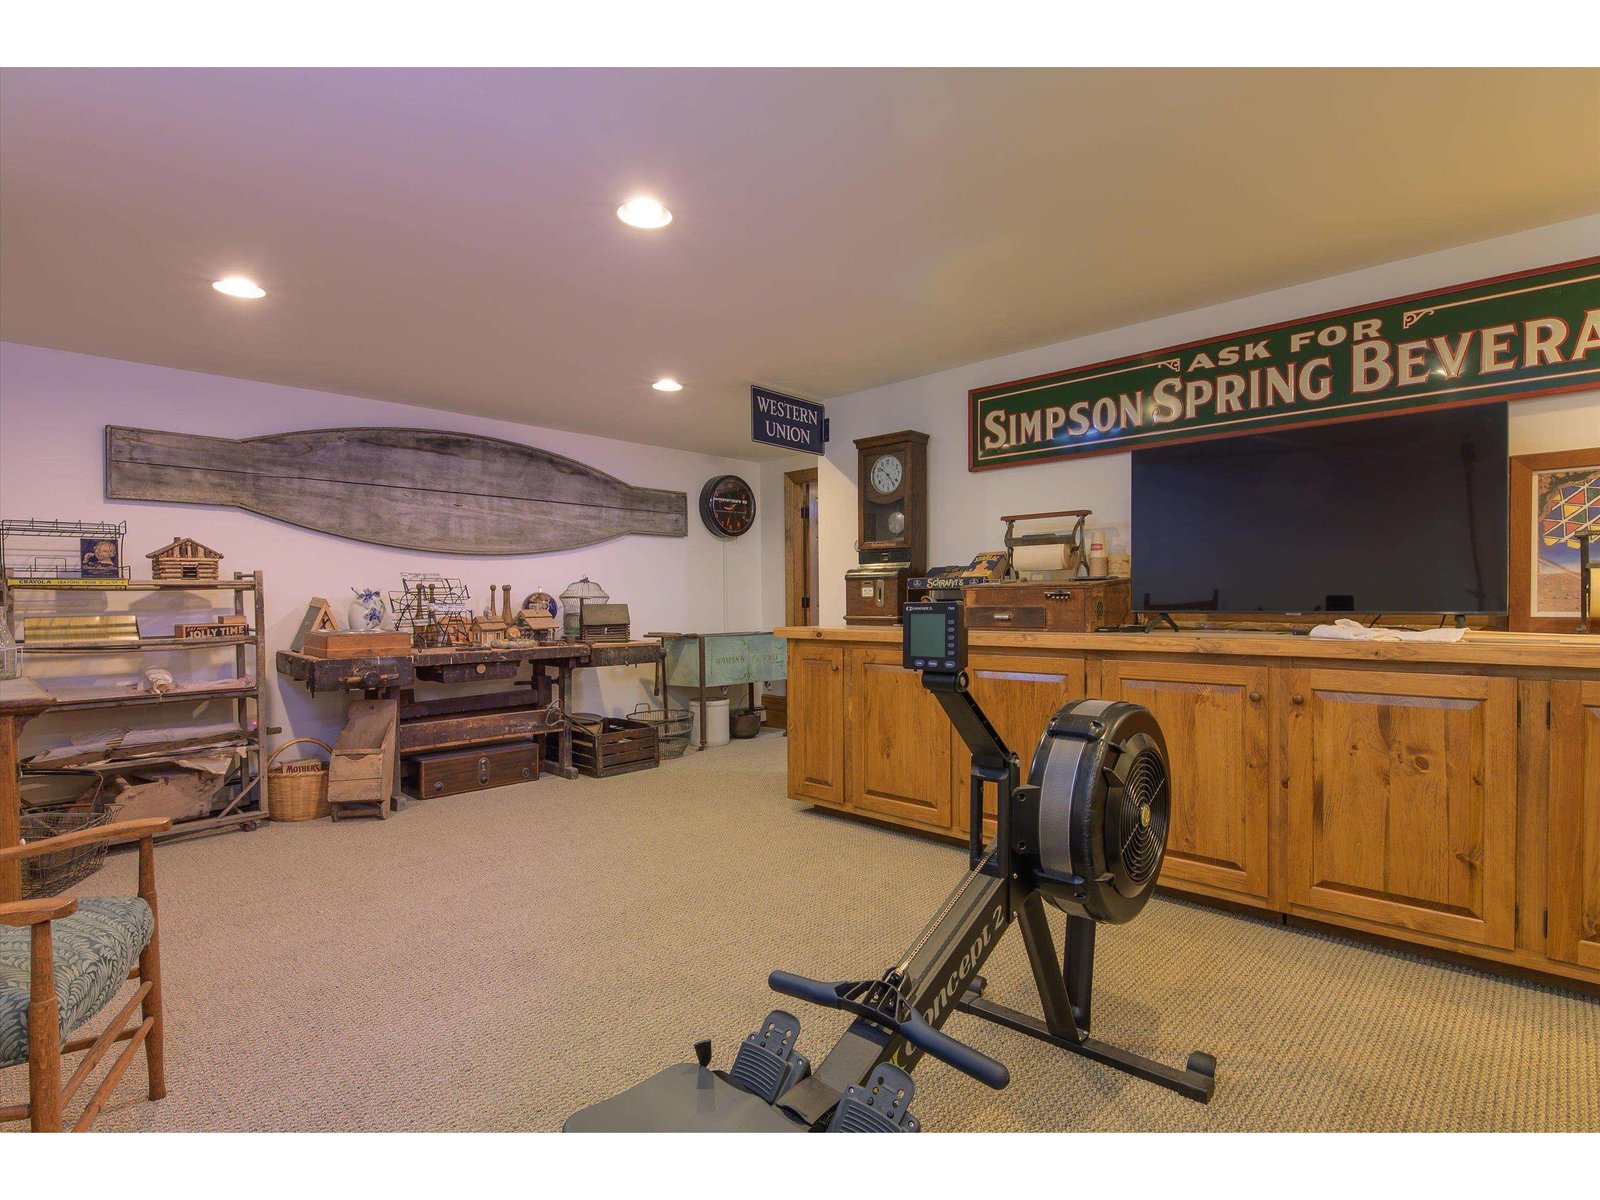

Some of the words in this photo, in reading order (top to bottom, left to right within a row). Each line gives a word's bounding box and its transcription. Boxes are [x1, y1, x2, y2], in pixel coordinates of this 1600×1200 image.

[1187, 339, 1272, 372] ASK
[1290, 318, 1383, 353] FOR
[983, 390, 1143, 451] SIMPSON
[1152, 355, 1334, 426] SPRING
[1350, 307, 1600, 394] BEVERA
[757, 395, 818, 425] WESTERN
[766, 420, 810, 444] UNION
[188, 628, 218, 639] JOLLY
[220, 625, 244, 636] TIME
[286, 764, 320, 774] MOTHER'S
